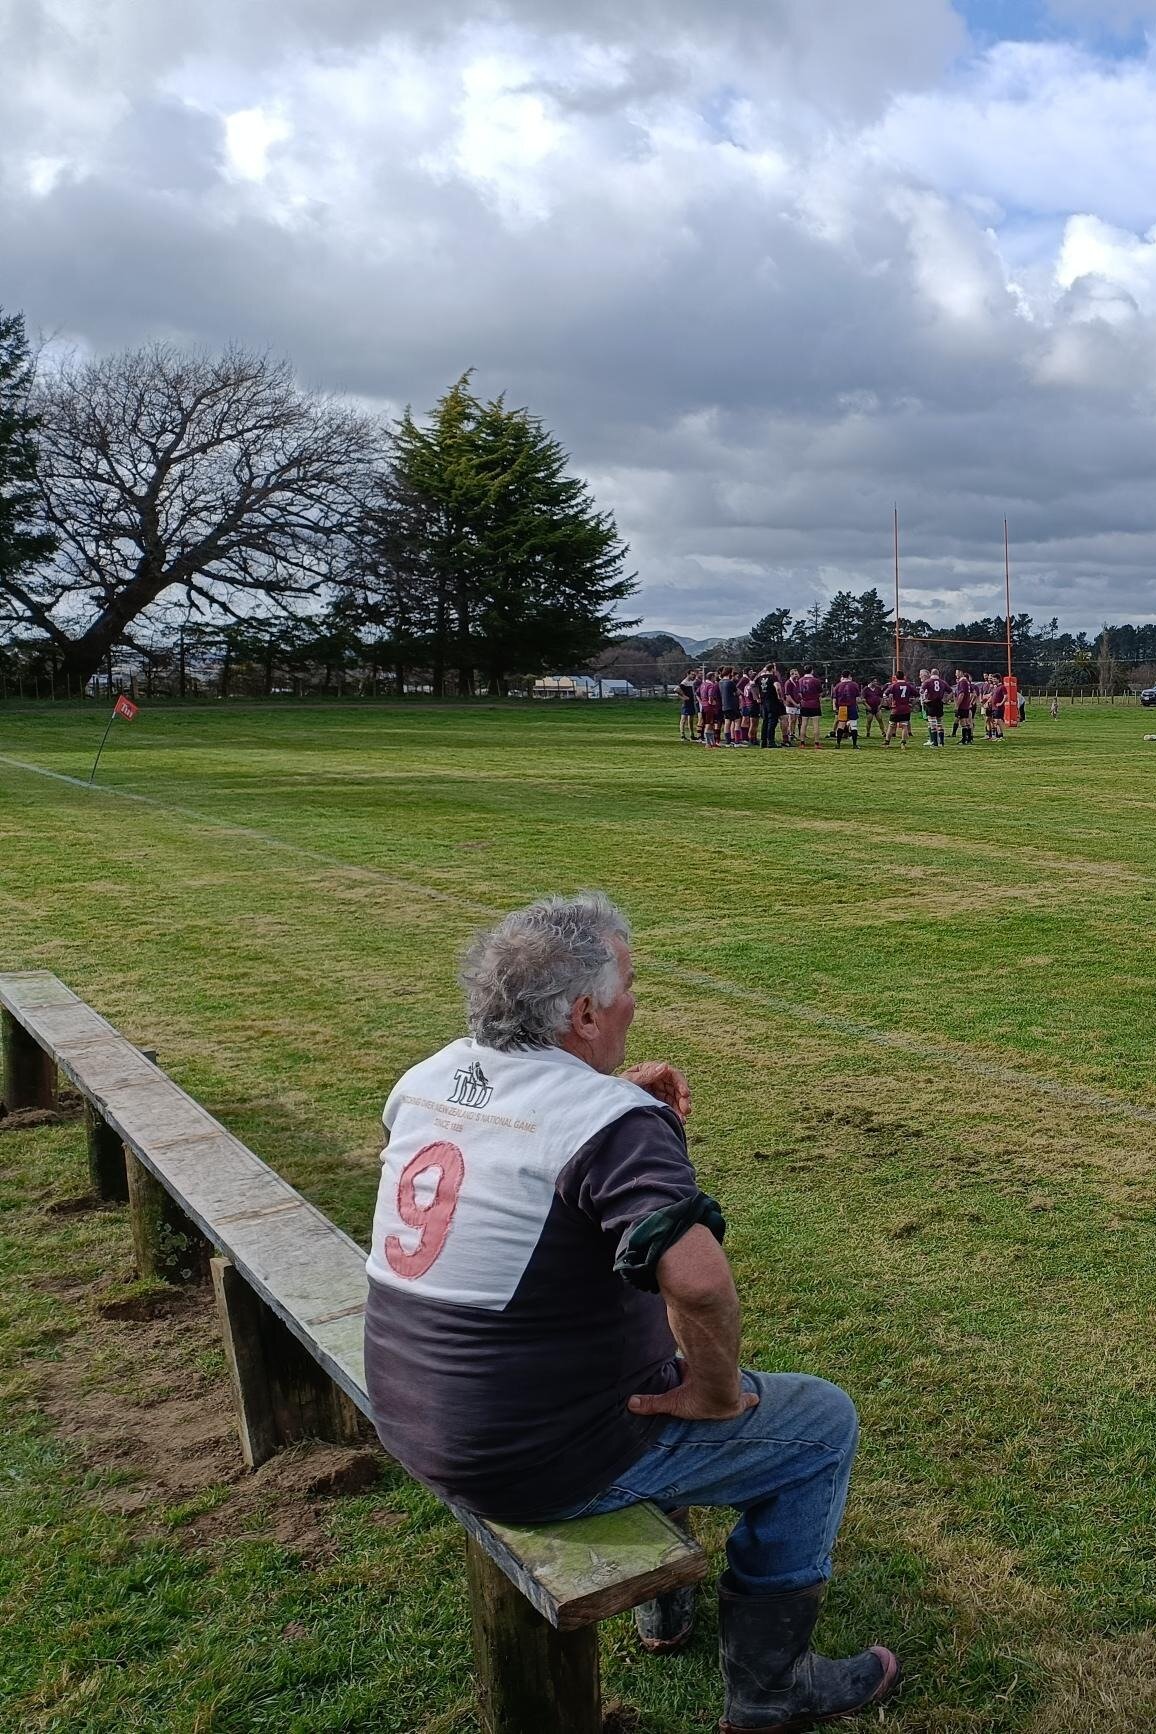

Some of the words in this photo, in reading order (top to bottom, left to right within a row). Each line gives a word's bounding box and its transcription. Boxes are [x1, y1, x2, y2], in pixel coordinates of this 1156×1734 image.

[899, 685, 907, 698] 7
[933, 680, 940, 692] 8
[435, 1102, 448, 1115] NEW
[482, 1113, 512, 1128] NATIONAL
[514, 1120, 537, 1133] GAME
[384, 1140, 466, 1280] 9
